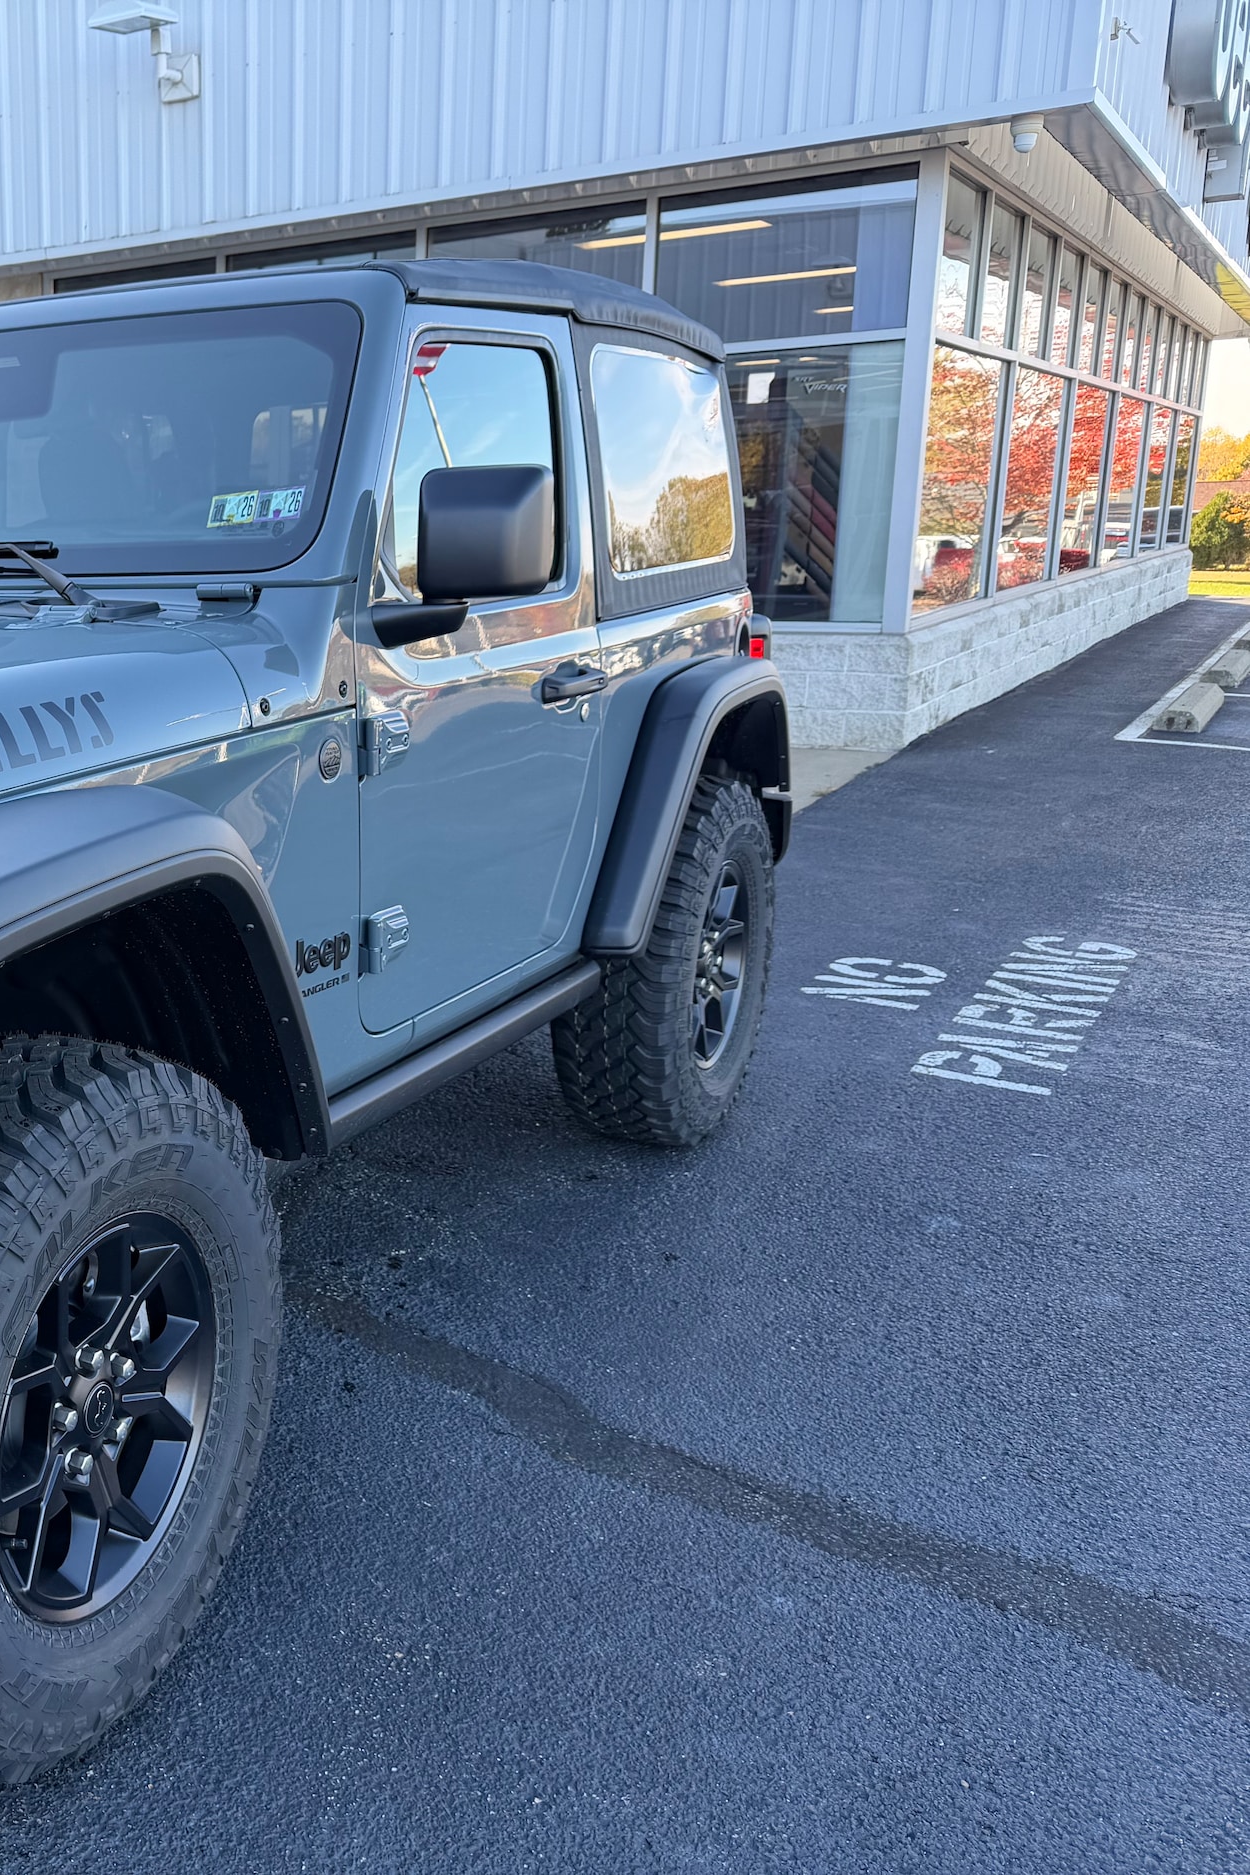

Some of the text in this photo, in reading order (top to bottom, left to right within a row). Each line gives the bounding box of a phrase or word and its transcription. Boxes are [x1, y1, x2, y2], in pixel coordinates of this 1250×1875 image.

[804, 380, 848, 395] VIPER
[240, 496, 255, 518] 26
[287, 490, 303, 513] 26
[295, 931, 351, 978] Jeep
[301, 977, 340, 998] ANGLER
[800, 956, 948, 1011] NO
[910, 935, 1138, 1096] PARKING
